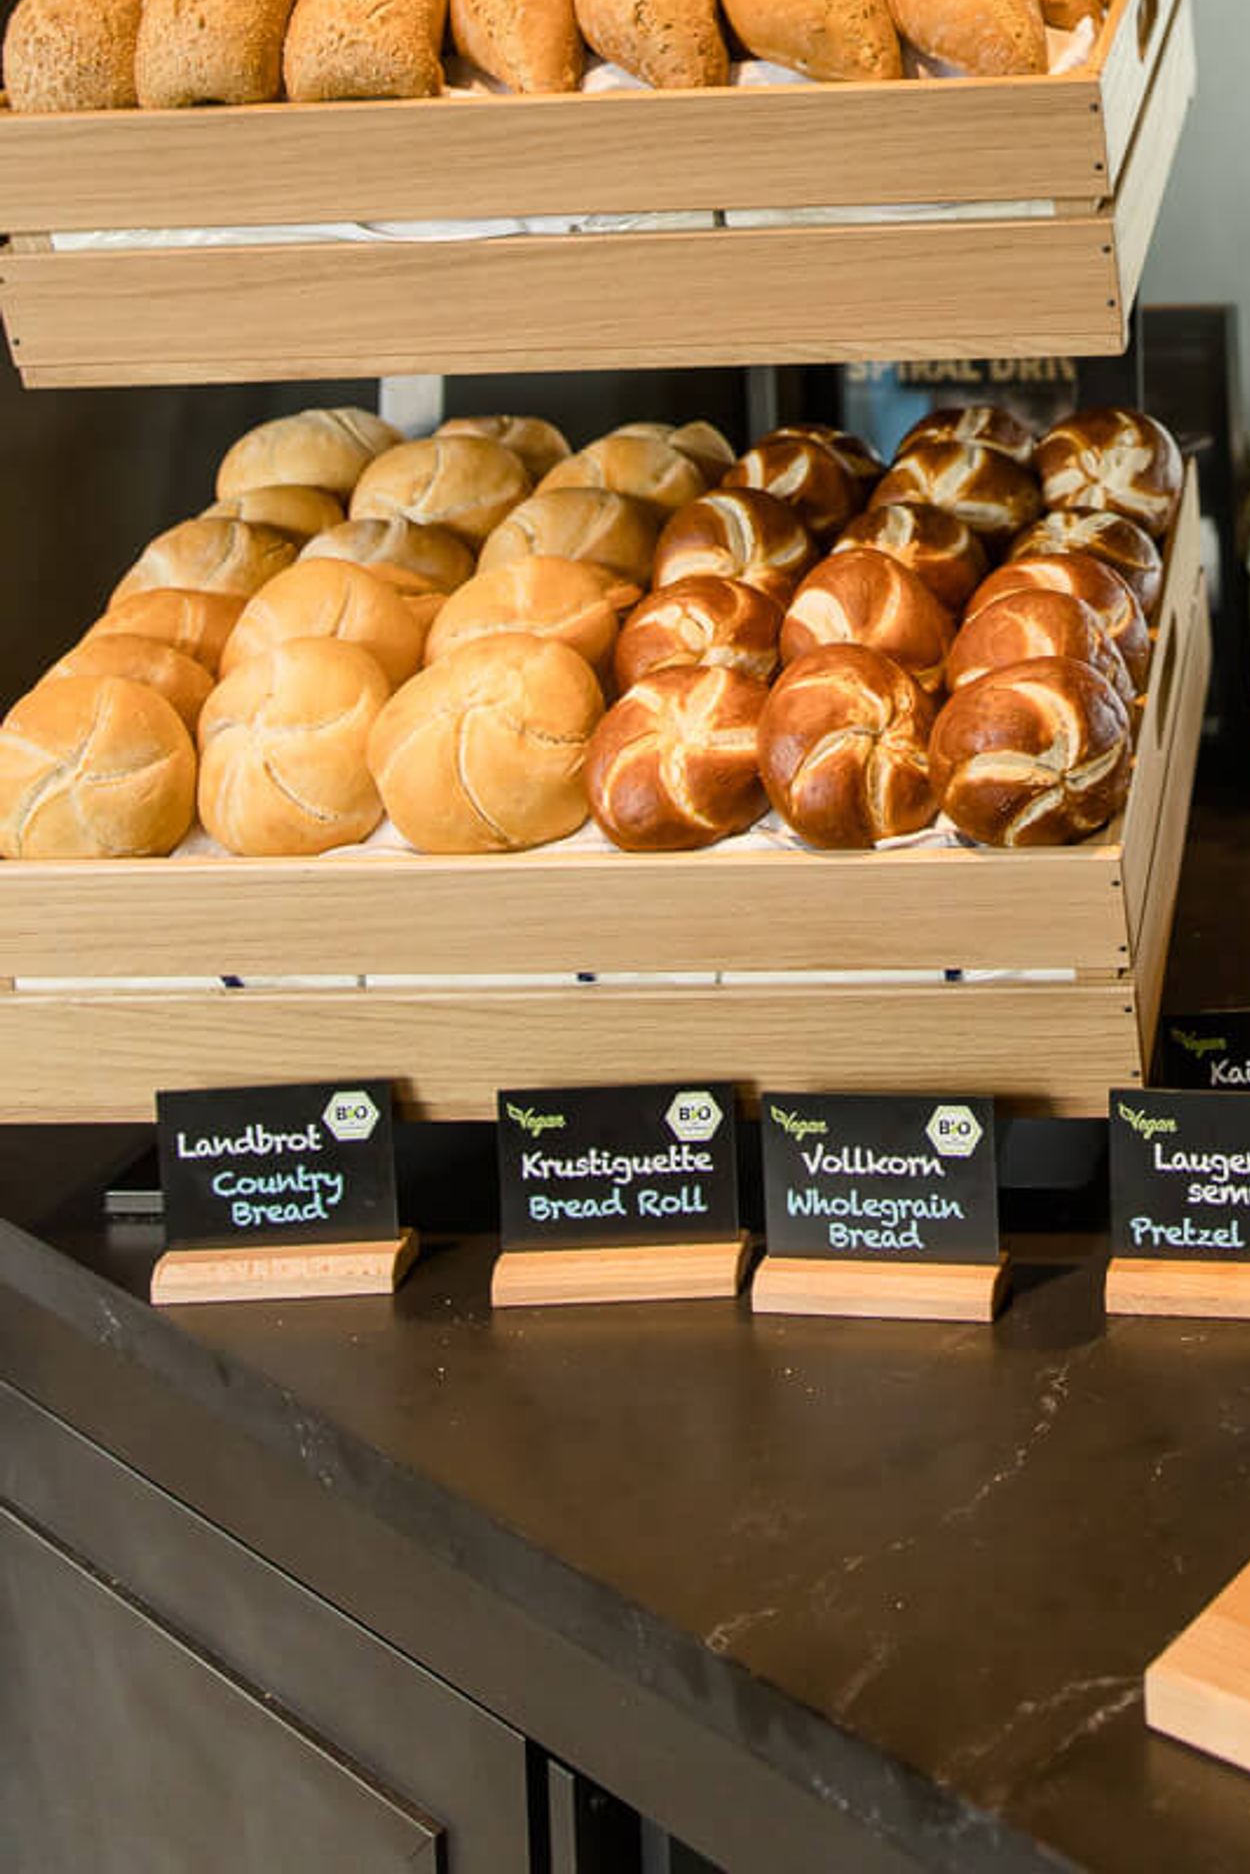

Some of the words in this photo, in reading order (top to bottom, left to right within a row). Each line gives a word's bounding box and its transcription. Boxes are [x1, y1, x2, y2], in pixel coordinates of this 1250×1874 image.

[1118, 1102, 1179, 1140] Vegan
[176, 1123, 323, 1159] Landbrot
[521, 1144, 714, 1185] Krustiguette
[800, 1142, 946, 1177] Vollkorn
[211, 1164, 344, 1206] Country
[528, 1186, 627, 1221] Bread
[637, 1184, 709, 1217] Roll
[231, 1192, 329, 1227] Bread
[786, 1187, 965, 1227] Wholegrain
[828, 1220, 926, 1249] Bread
[1129, 1216, 1245, 1247] Pretzel
